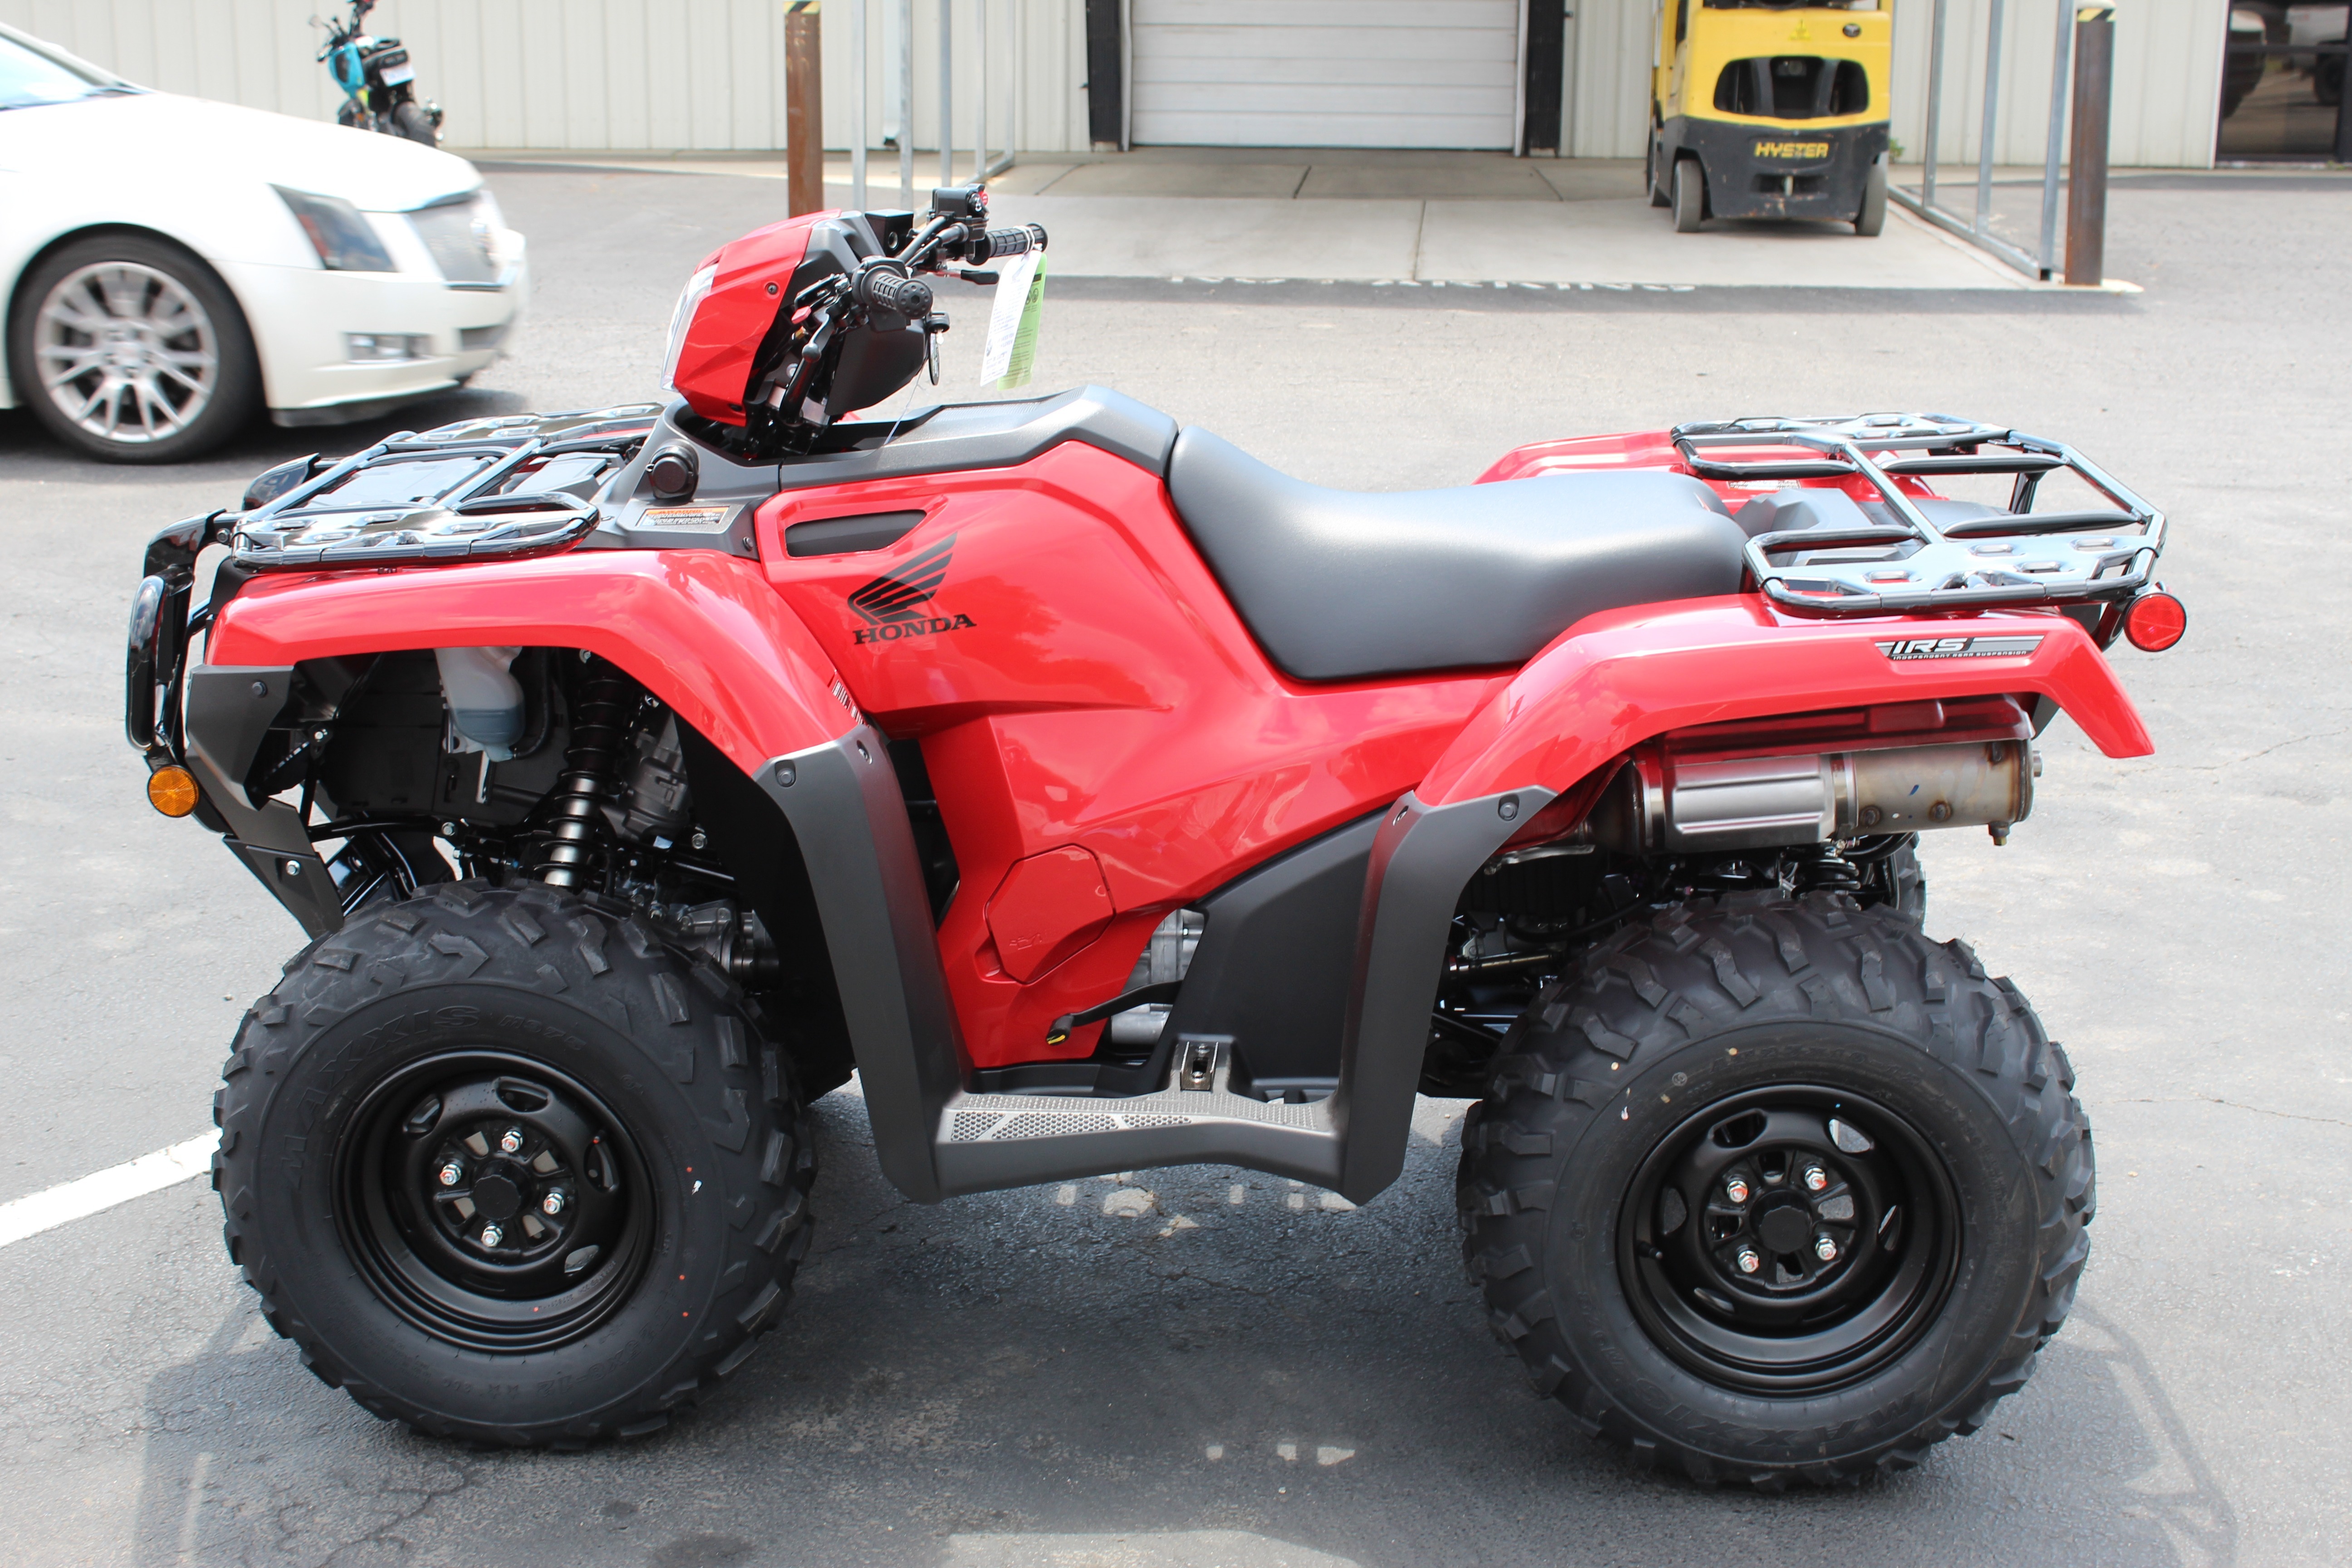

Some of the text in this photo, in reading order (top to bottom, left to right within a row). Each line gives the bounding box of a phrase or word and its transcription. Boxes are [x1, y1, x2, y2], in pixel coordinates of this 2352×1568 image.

[1755, 142, 1829, 158] HYSTER
[853, 613, 977, 645] HONDA
[1892, 637, 1968, 654] IRS
[281, 1005, 480, 1191] MAXXIS
[1635, 1377, 1916, 1447] MAXXIS
